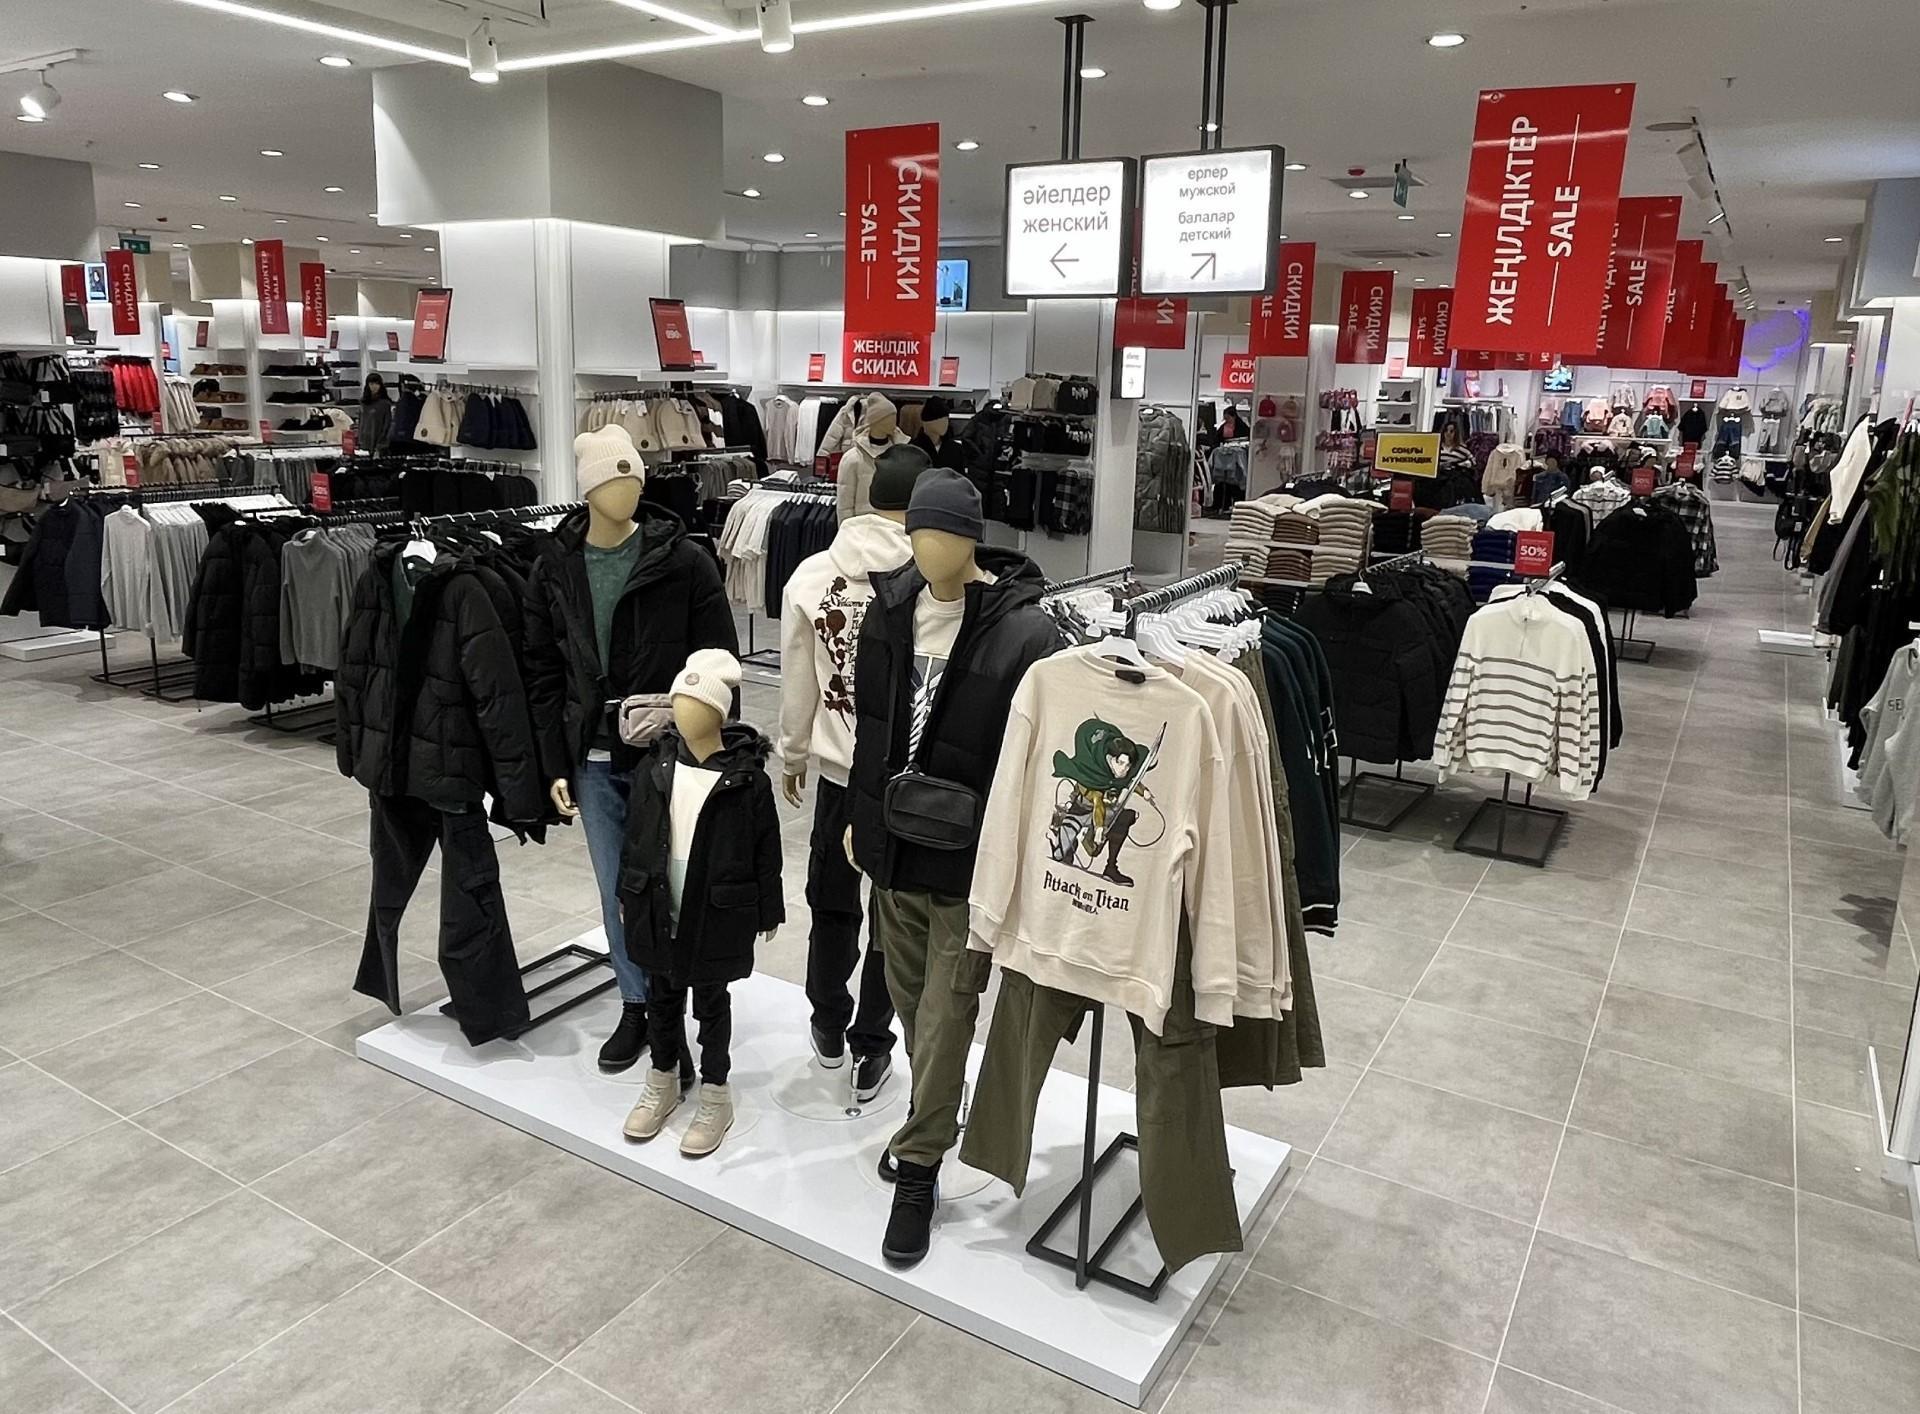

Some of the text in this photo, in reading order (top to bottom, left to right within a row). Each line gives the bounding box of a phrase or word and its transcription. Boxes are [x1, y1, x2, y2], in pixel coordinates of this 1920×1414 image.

[1188, 167, 1228, 182] ерлер
[1023, 184, 1111, 206] әйелдер
[1179, 182, 1236, 200] мужской
[892, 160, 922, 300] СКИДКИ
[1023, 210, 1108, 233] женский
[1178, 211, 1235, 225] балалар
[1486, 116, 1538, 325] ЖЕҢІЛДІКТЕР
[1547, 186, 1580, 258] SALE
[860, 203, 878, 263] SALE
[1178, 227, 1231, 243] детский
[1626, 260, 1648, 307] SALE
[1261, 294, 1273, 318] ALE
[1282, 262, 1303, 340] СКИДКИ
[1347, 304, 1359, 333] SALE
[1365, 286, 1384, 350] СКИДКИ
[1416, 316, 1427, 340] SALE
[1432, 301, 1449, 355] СКИДКИ
[853, 340, 920, 356] ЖЕҢІЛДІК
[852, 358, 919, 378] СКИДКА
[1520, 545, 1547, 557] 50%
[1043, 870, 1081, 899] Attack
[1082, 891, 1093, 902] on
[1095, 889, 1129, 911] Titan
